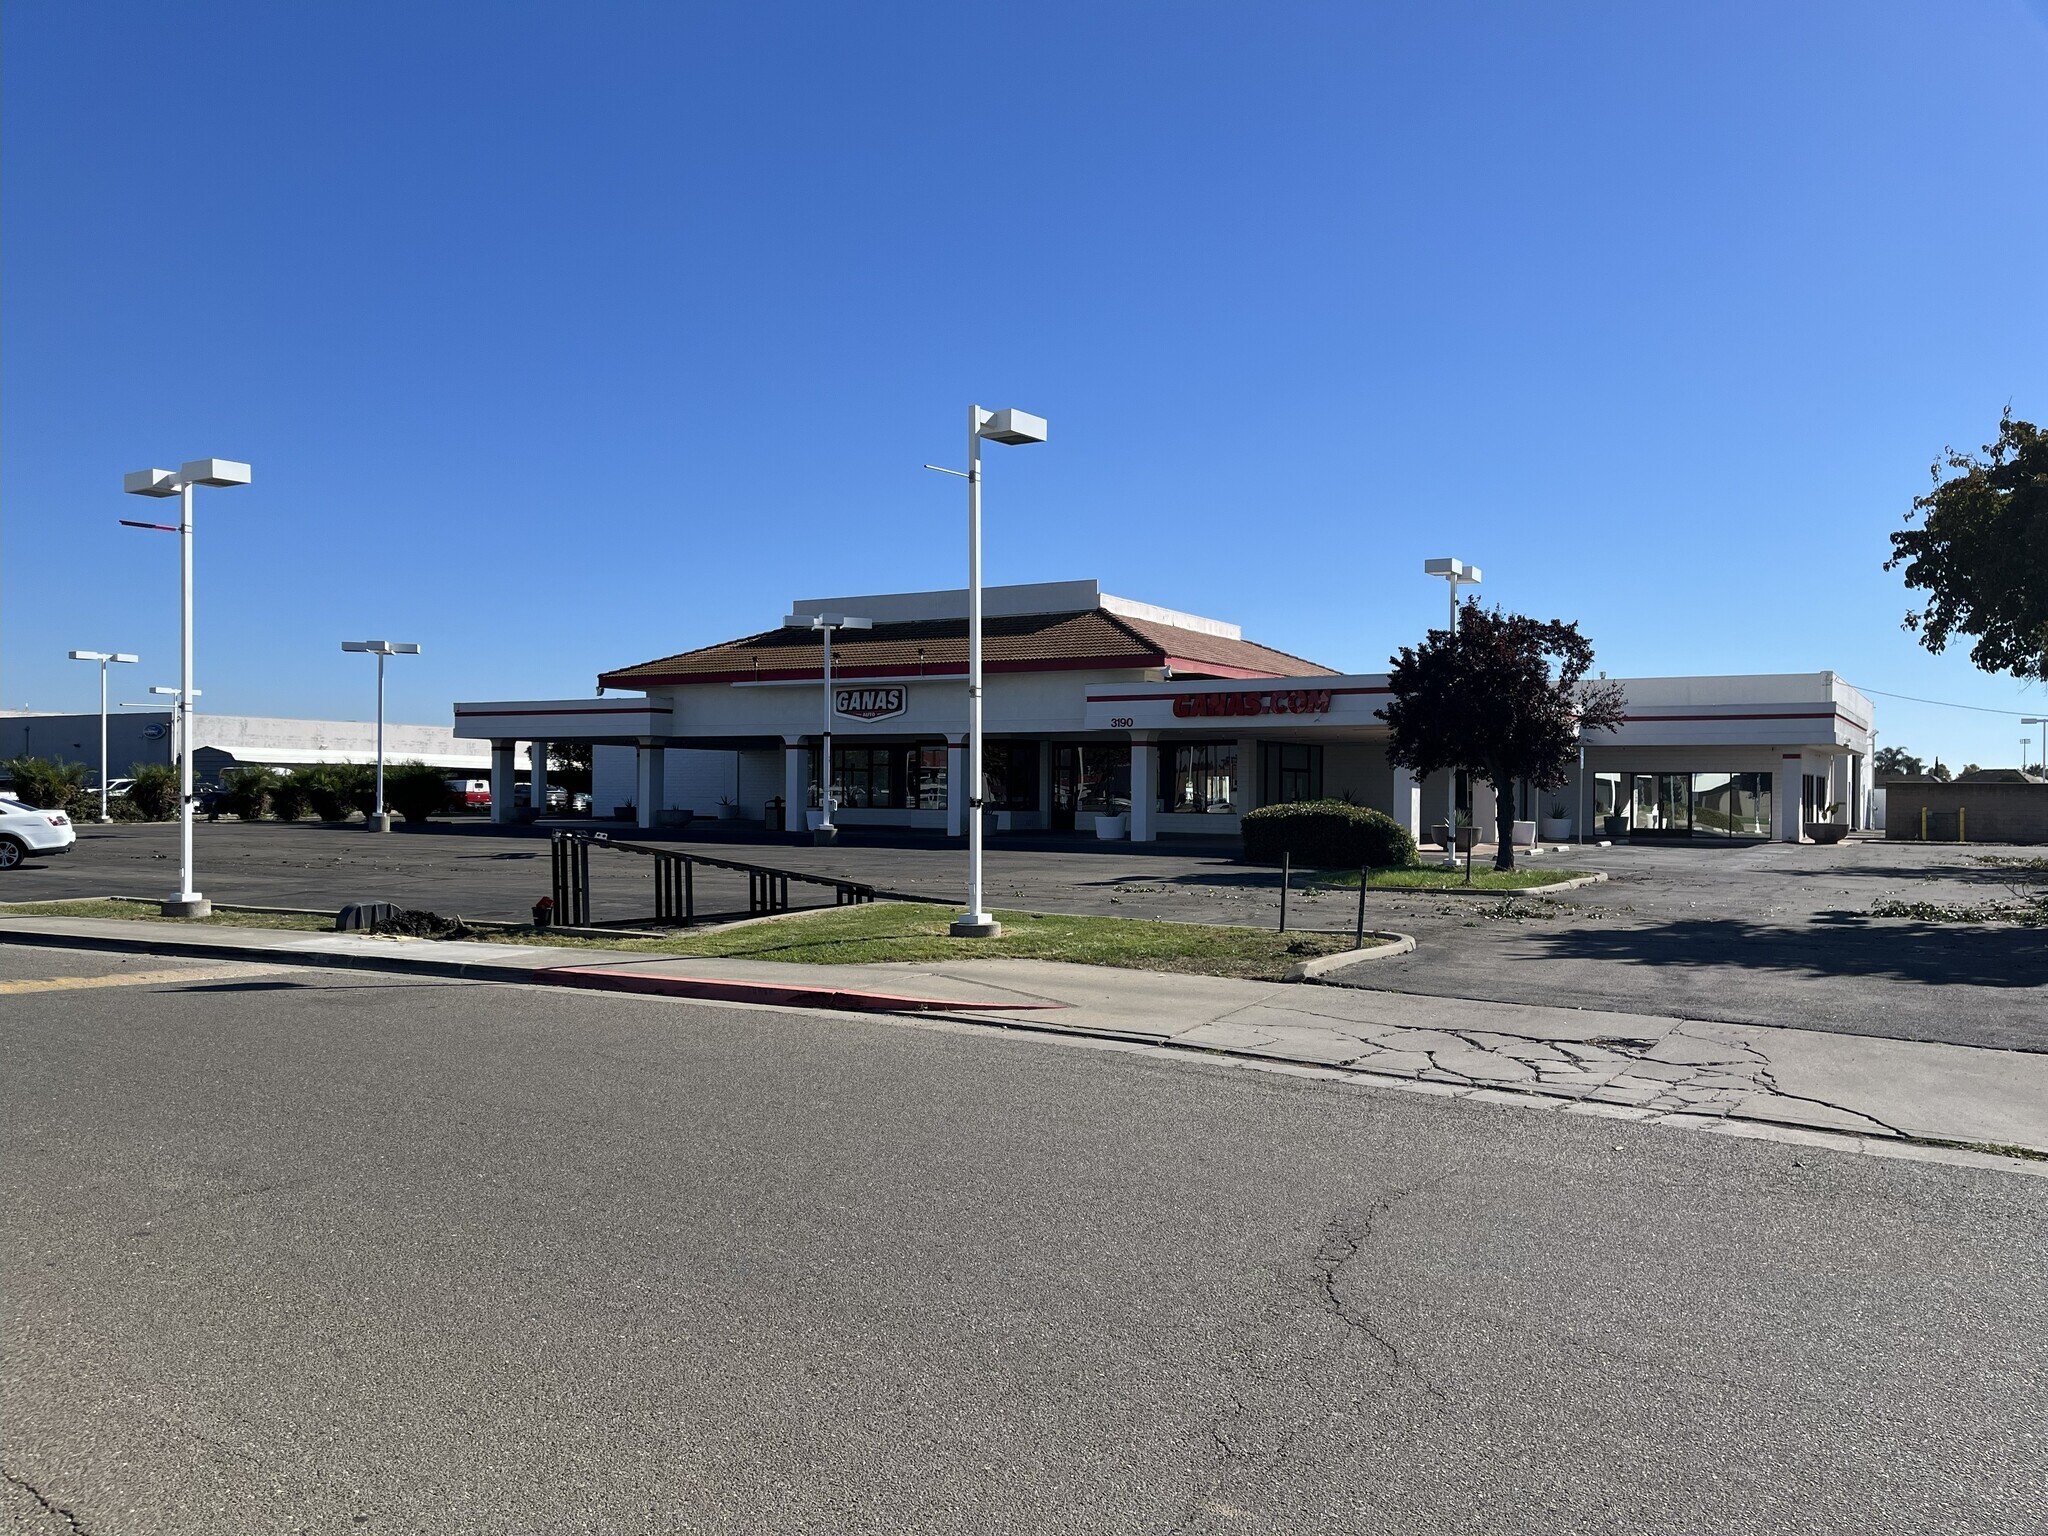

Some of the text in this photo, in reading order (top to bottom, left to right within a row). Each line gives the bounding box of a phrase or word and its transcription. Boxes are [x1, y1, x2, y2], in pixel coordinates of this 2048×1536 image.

[837, 690, 900, 711] GANAS
[1172, 690, 1332, 717] GANAS.COM
[1110, 717, 1134, 728] 3190
